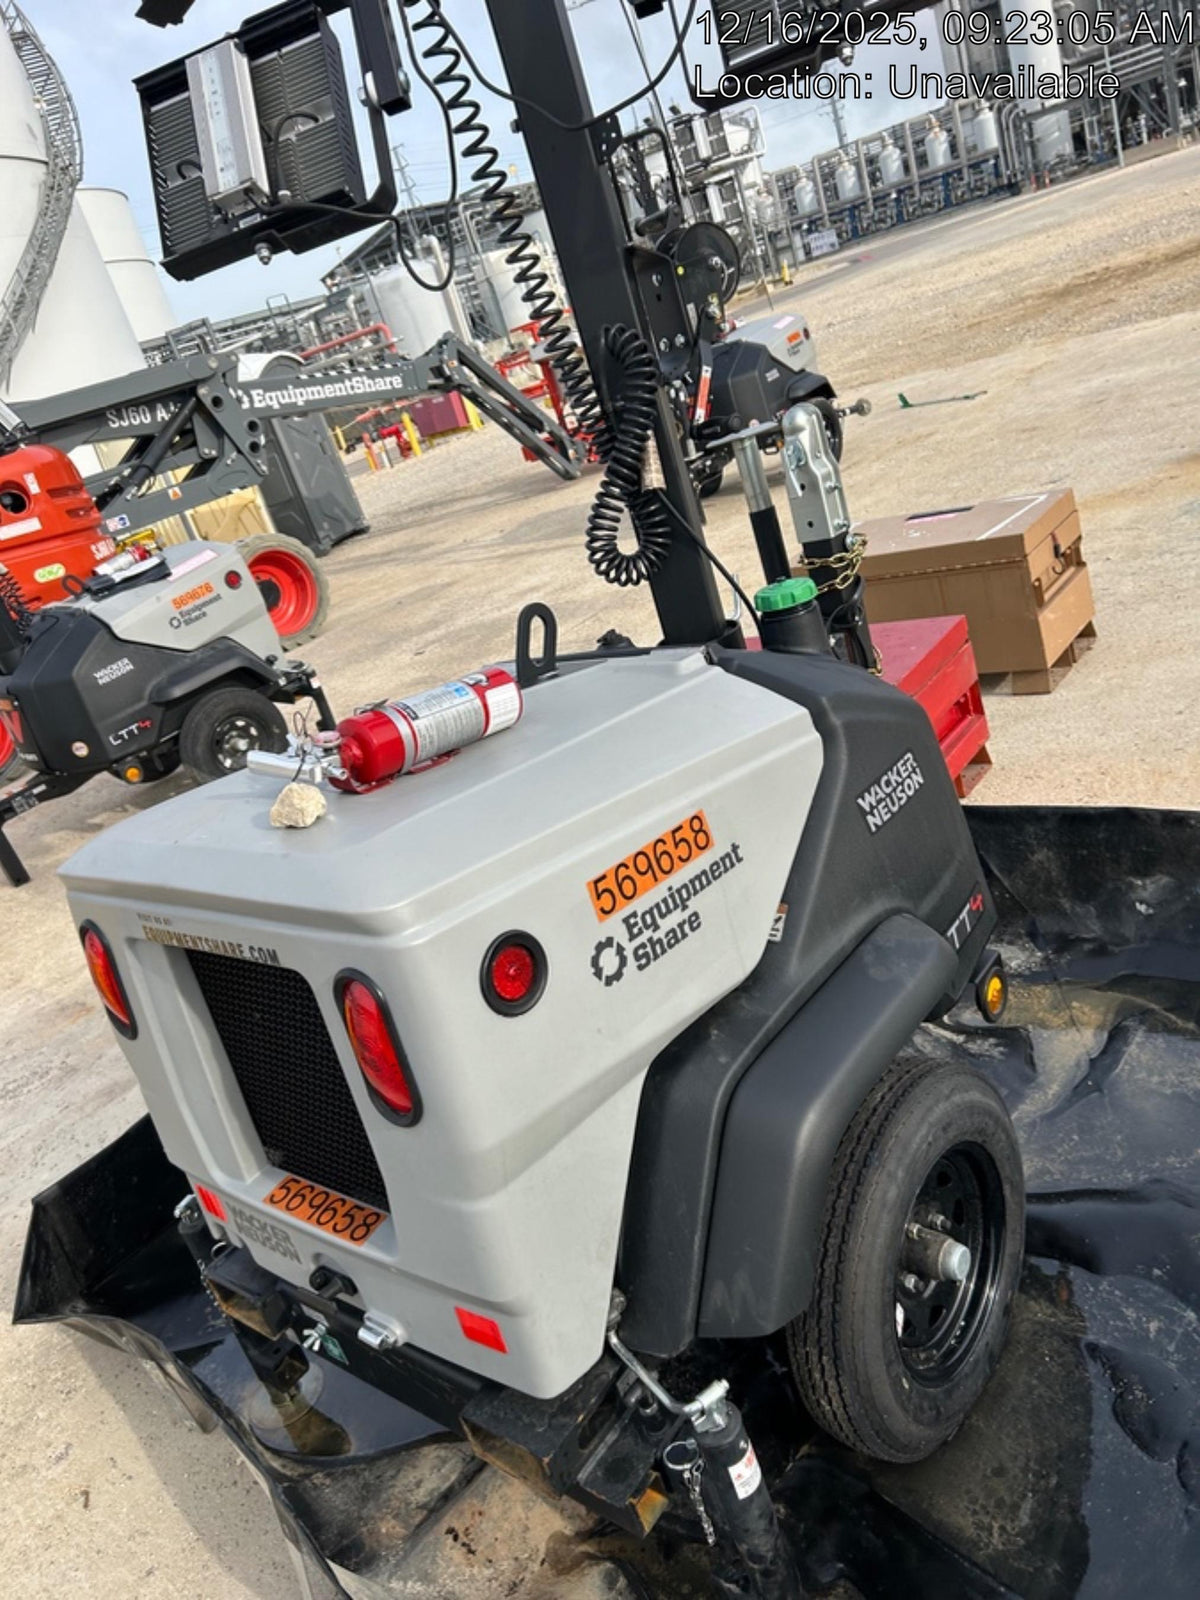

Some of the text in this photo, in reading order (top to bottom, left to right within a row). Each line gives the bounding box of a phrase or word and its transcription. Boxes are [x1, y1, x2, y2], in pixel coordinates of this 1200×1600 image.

[105, 404, 152, 429] SJ60
[250, 374, 404, 410] EquipmentShare
[856, 751, 918, 813] WACKER
[864, 767, 925, 833] NEUSON
[592, 814, 711, 916] 569658
[621, 841, 744, 943] Equipment
[632, 910, 702, 972] Share
[268, 1176, 382, 1242] 569658
